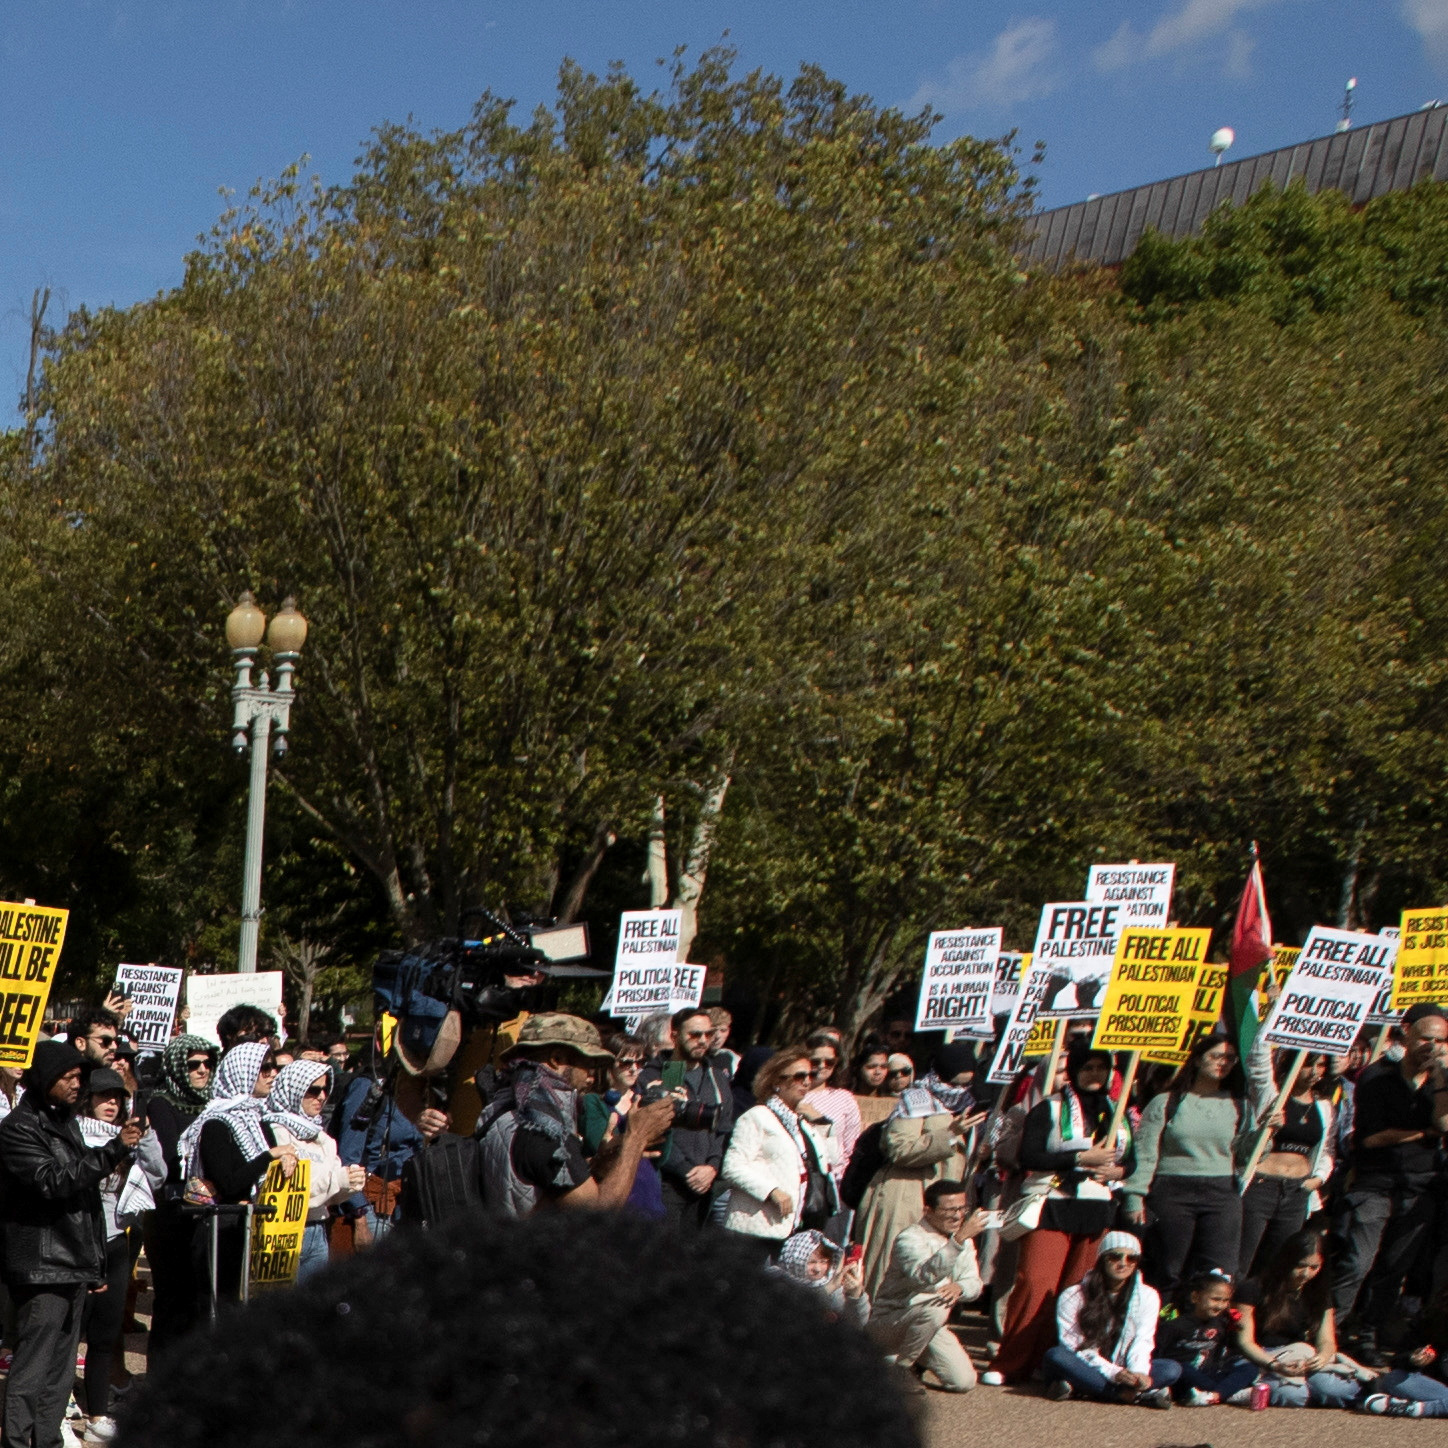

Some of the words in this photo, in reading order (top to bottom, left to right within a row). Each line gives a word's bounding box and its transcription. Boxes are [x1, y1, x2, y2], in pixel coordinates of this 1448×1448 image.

[1095, 870, 1168, 886] RESISTANCE
[1104, 886, 1155, 901] AGAINST
[624, 919, 659, 938] FREE
[660, 917, 679, 936] ALL
[1047, 905, 1120, 940] FREE
[622, 939, 677, 954] PALESTINIAN
[933, 933, 998, 950] RESISTANCE
[1039, 938, 1118, 958] PALESTINE
[1122, 935, 1172, 962] FREE
[1171, 937, 1201, 962] ALL
[1404, 935, 1417, 950] IS
[940, 948, 986, 963] AGAINST
[1306, 937, 1359, 965] FREE
[1355, 945, 1391, 969] ALL
[25, 945, 54, 983] BE
[930, 961, 994, 978] OCCUPATION
[1117, 964, 1197, 983] PALESTINIAN
[1297, 960, 1383, 987] PALESTINIAN
[1402, 963, 1436, 979] WHEN
[121, 968, 179, 983] RESISTANCE
[619, 967, 671, 986] POLITICAL
[929, 983, 938, 996] IS
[940, 983, 948, 994] A
[950, 981, 990, 995] HUMAN
[1399, 980, 1419, 993] ARE
[925, 995, 987, 1019] RIGHT!
[1117, 994, 1181, 1013] POLITICAL
[1283, 993, 1365, 1023] POLITICAL
[135, 1010, 171, 1022] HUMAN
[1105, 1014, 1184, 1034] PRISONERS!
[1273, 1014, 1356, 1042] PRISONERS
[283, 1194, 304, 1223] AID
